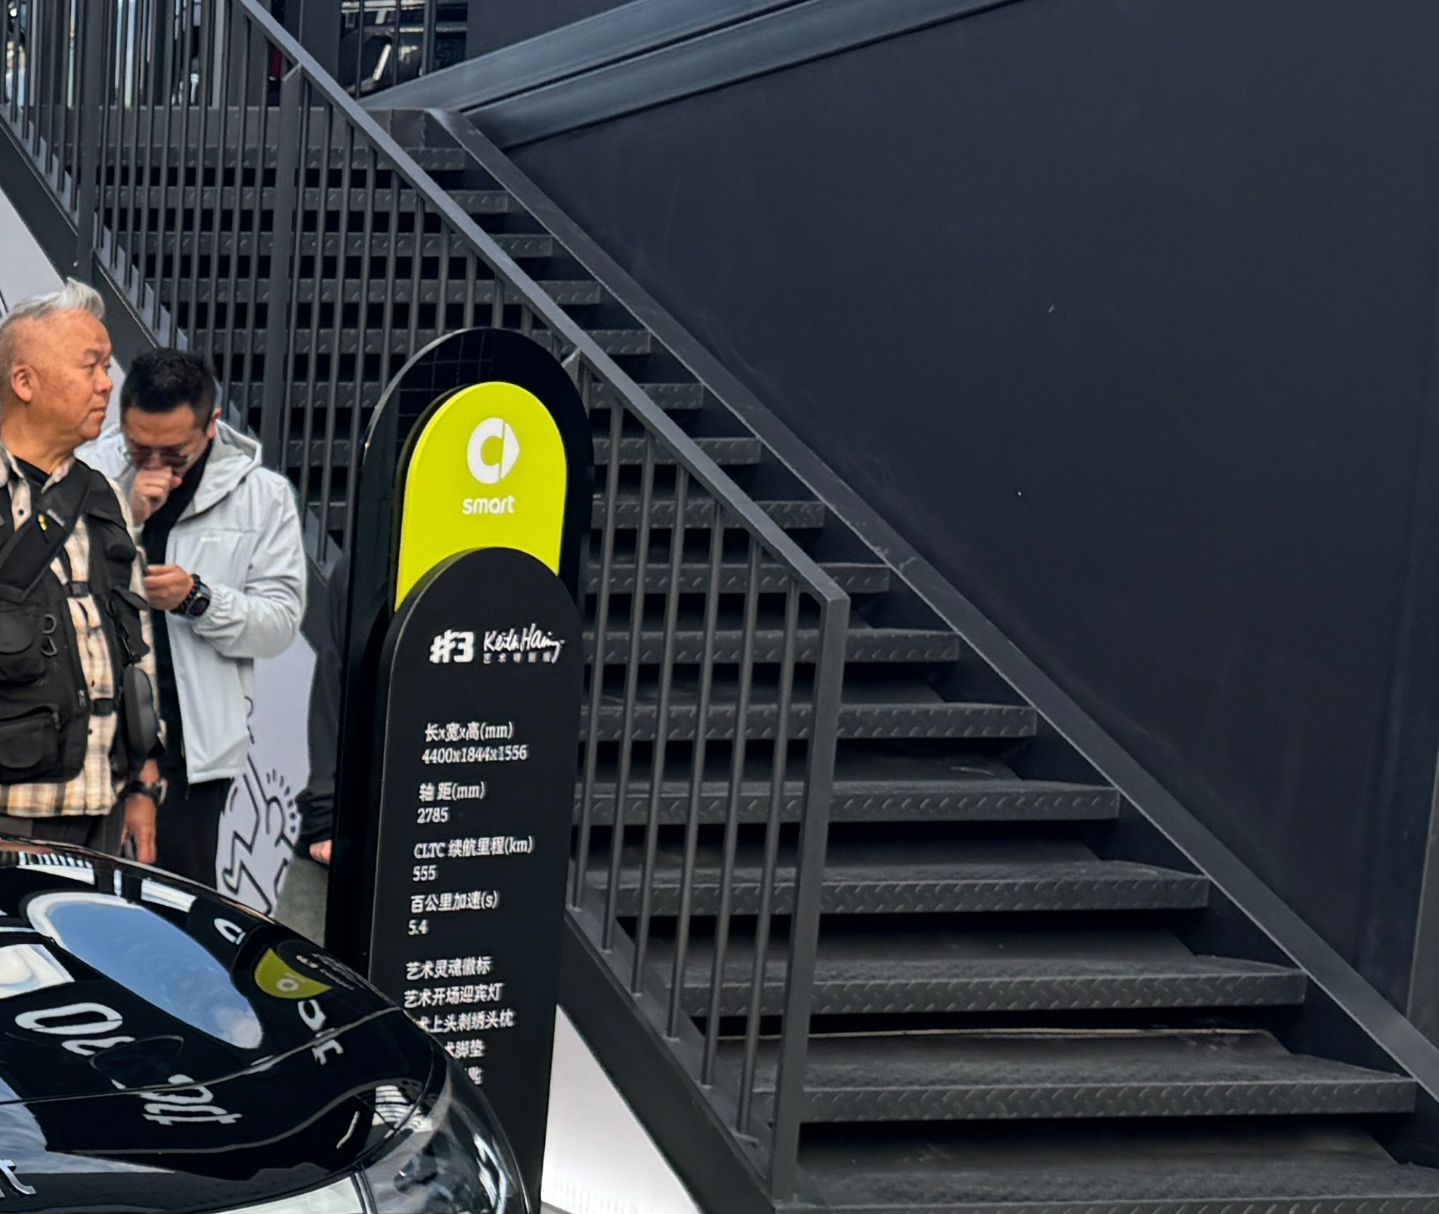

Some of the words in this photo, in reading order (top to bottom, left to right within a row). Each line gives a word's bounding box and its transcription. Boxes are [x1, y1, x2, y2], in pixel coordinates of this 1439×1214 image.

[462, 495, 515, 515] smart
[417, 807, 449, 823] 2785
[413, 842, 446, 859] CLTC
[412, 865, 438, 881] 555
[410, 890, 500, 914] 百公里加速(s)
[408, 919, 429, 935] 5.4
